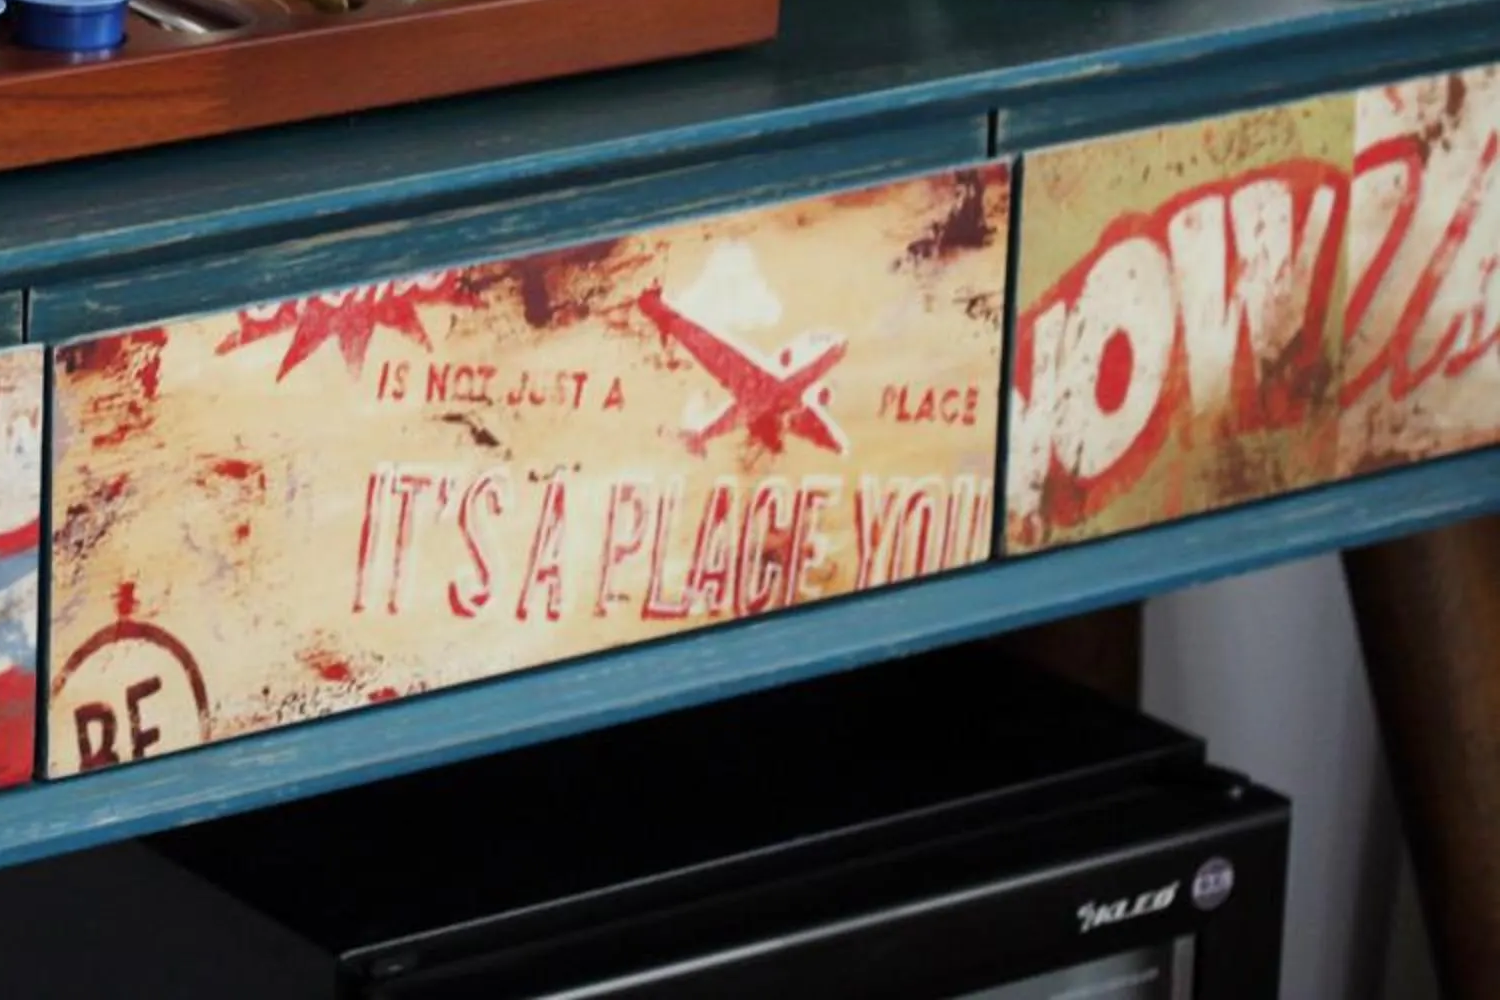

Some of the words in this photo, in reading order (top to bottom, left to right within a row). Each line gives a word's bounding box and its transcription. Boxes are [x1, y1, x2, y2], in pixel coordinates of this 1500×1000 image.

[376, 359, 410, 401] IS
[425, 362, 497, 405] NOT
[505, 369, 588, 410] JUST
[602, 375, 625, 411] A
[876, 382, 980, 428] PLACE
[350, 460, 510, 620] IT'S
[514, 462, 580, 623] A
[593, 472, 844, 621] PLACE
